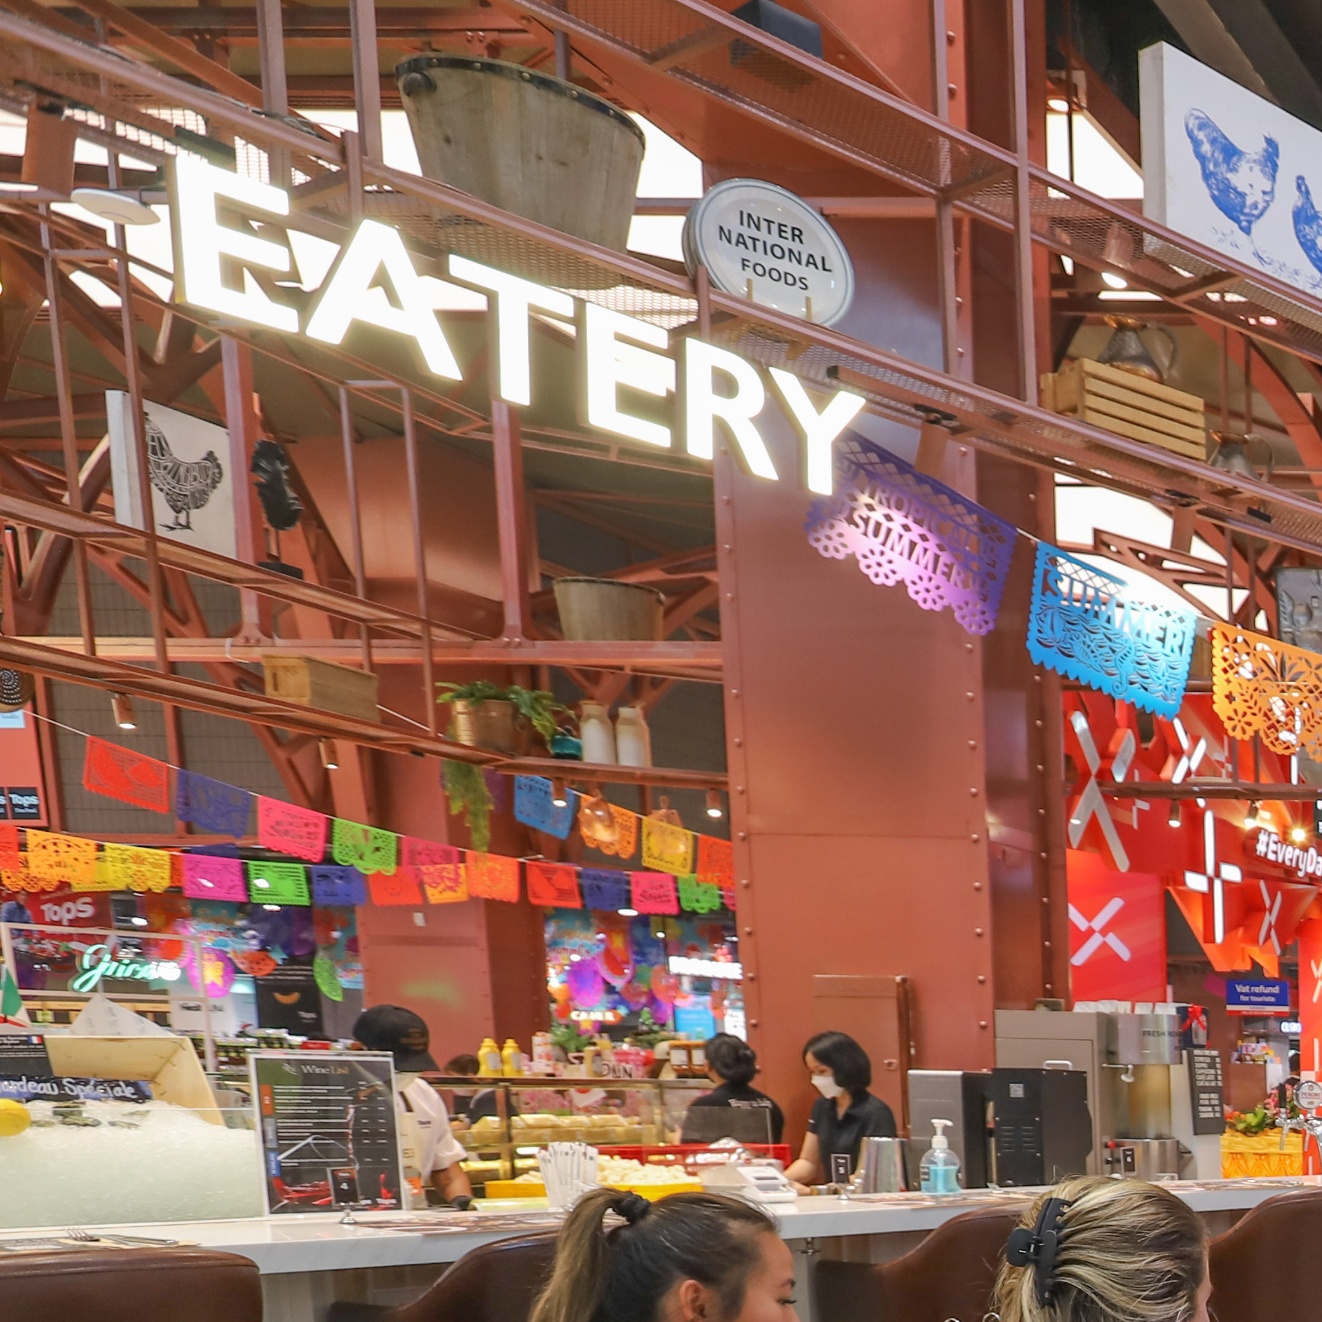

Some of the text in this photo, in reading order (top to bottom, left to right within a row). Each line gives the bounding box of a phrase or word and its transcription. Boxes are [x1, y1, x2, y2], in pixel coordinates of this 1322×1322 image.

[738, 210, 804, 245] INTER
[718, 224, 833, 273] NATIONAL
[740, 257, 809, 291] FOODS
[172, 154, 865, 496] EATERY
[864, 480, 976, 552] TROPICAL
[851, 509, 968, 590] SUMMER
[1044, 566, 1190, 656] SUMMER
[1235, 984, 1280, 993] Vat refund
[301, 1065, 331, 1074] Wine
[62, 1075, 139, 1101] Spéciale
[339, 1182, 349, 1191] 4
